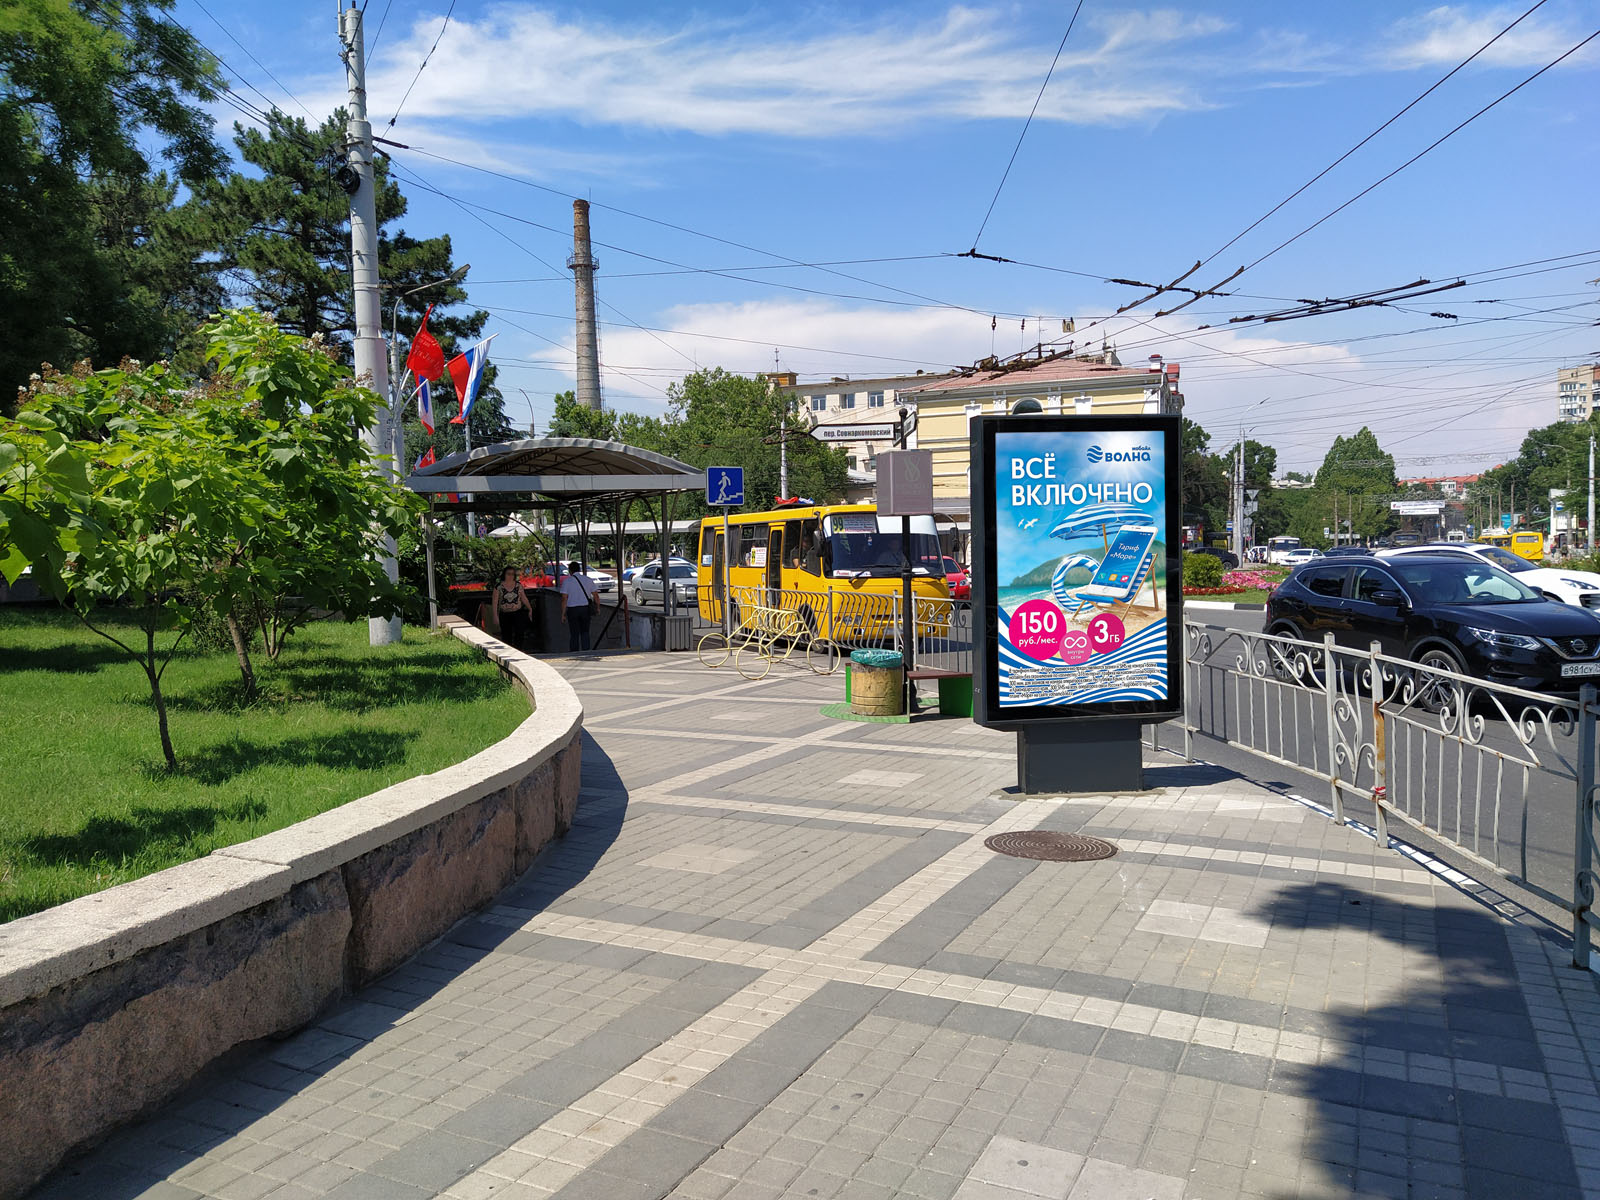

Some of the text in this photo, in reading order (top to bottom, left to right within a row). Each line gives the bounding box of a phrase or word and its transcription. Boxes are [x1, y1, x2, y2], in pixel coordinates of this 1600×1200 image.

[837, 428, 891, 437] Совнаркомовский
[1011, 452, 1056, 479] ВСЁ
[1011, 482, 1153, 506] ВКЛЮЧЕНО
[832, 516, 844, 531] 99
[1118, 543, 1140, 552] Тариф
[1018, 611, 1058, 634] 150
[1094, 619, 1109, 644] 3
[1018, 635, 1058, 647] руб./мес.
